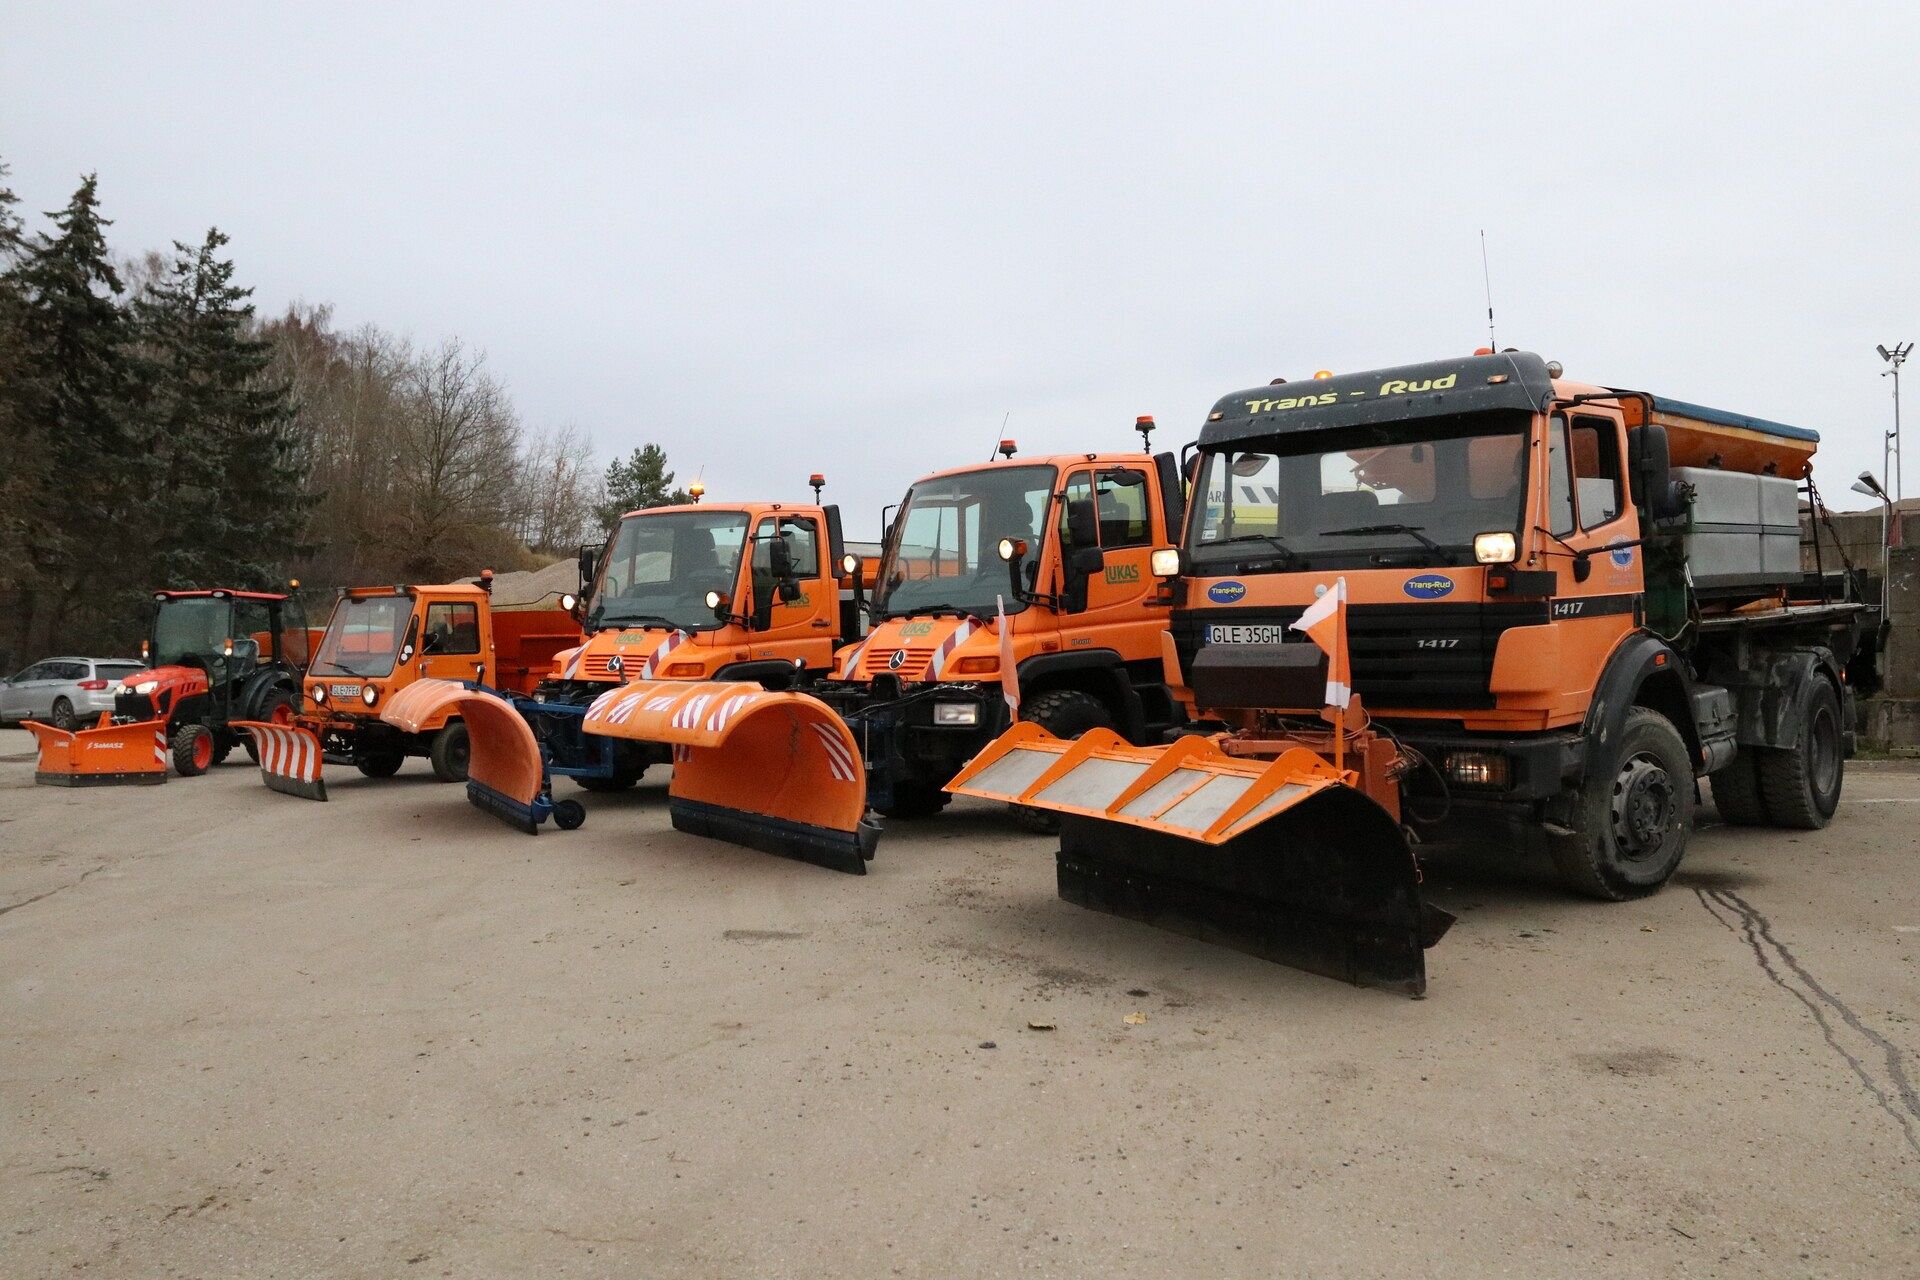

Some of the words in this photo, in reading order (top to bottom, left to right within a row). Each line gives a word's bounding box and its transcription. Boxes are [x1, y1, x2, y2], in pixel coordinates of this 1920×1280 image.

[1246, 392, 1338, 414] Trans
[1379, 373, 1457, 396] Rud
[1104, 564, 1139, 584] LUKAS
[1211, 586, 1244, 595] Trans-Rud
[1409, 581, 1451, 589] Trans-Rud
[1554, 602, 1584, 615] 1417
[1212, 627, 1241, 643] GLE
[1245, 627, 1280, 643] 35GH
[1417, 639, 1460, 648] 1417
